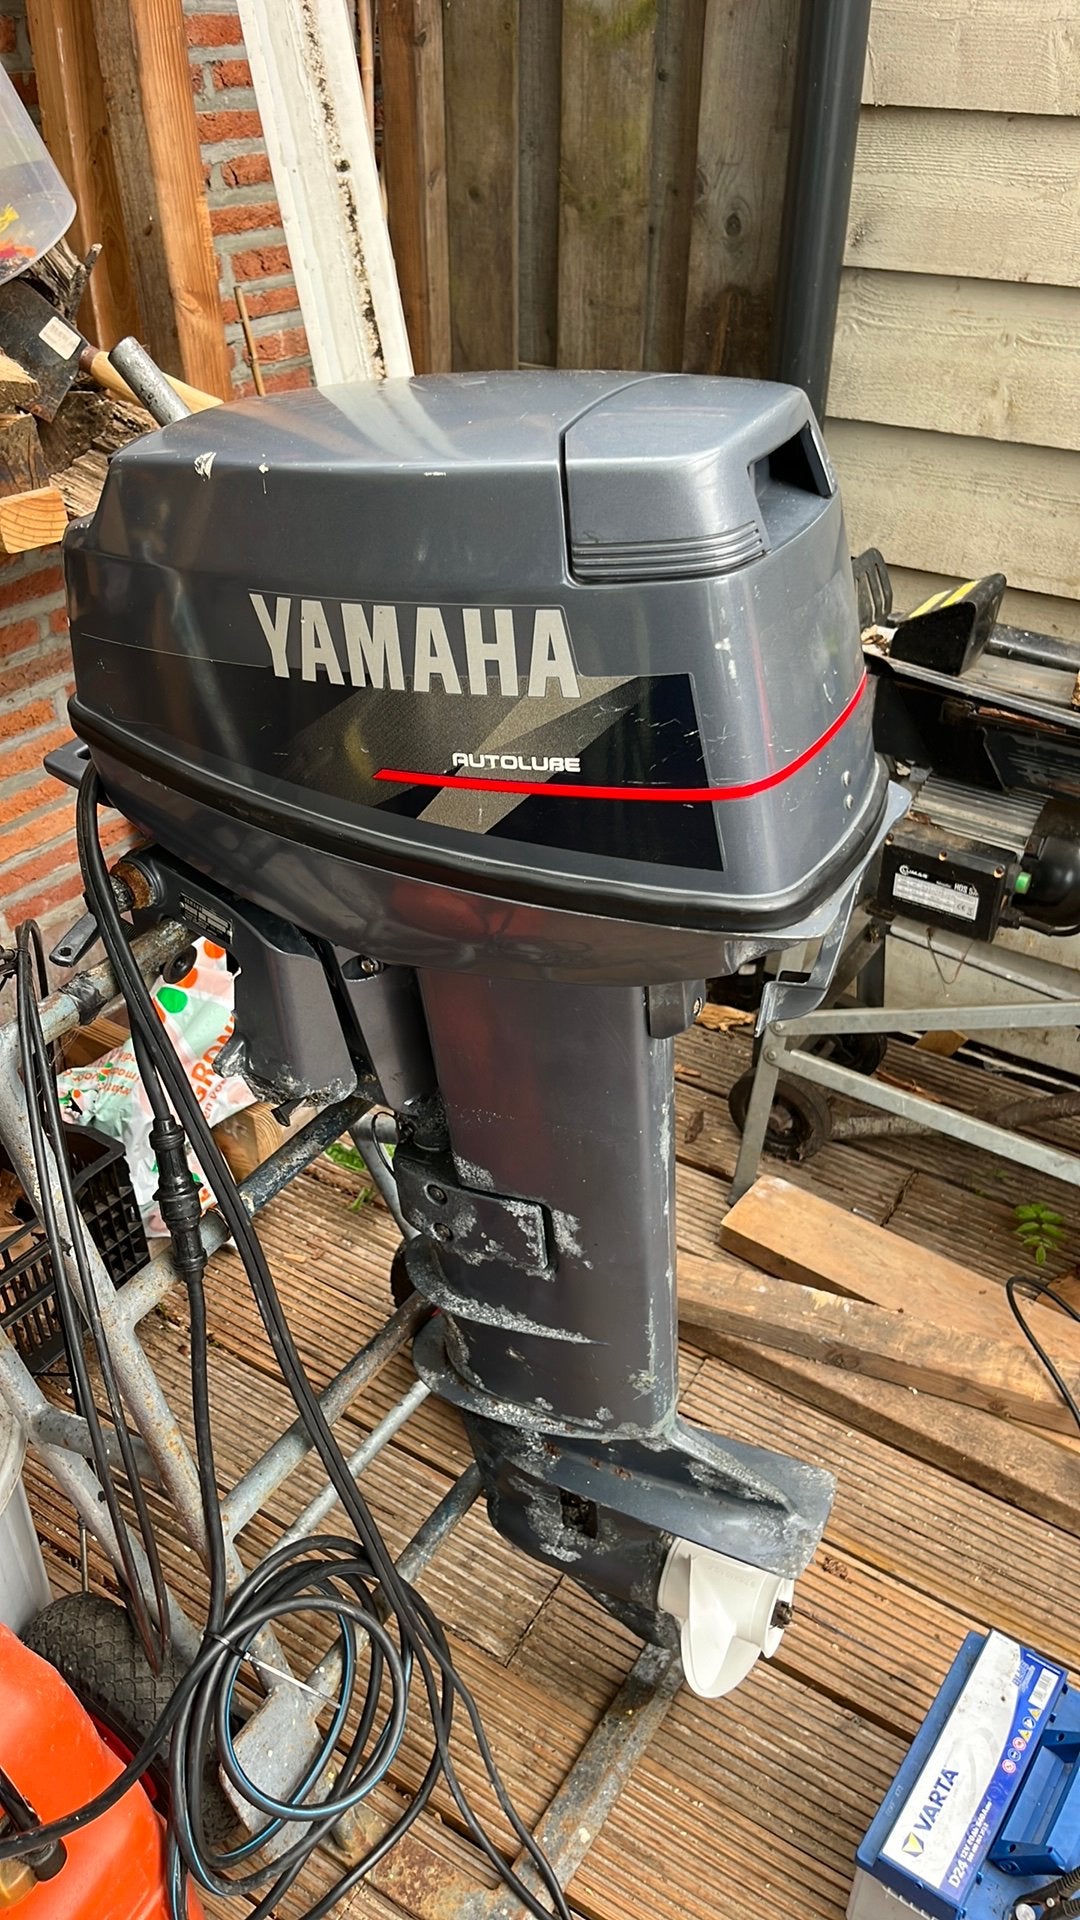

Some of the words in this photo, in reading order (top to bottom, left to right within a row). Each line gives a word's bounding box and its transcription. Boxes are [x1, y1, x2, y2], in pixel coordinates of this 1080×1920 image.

[249, 593, 581, 698] YAMAHA
[452, 752, 580, 772] AUTOLUBE
[913, 1769, 959, 1831] VARTA
[948, 1860, 968, 1888] D24
[960, 1846, 971, 1860] 12V
